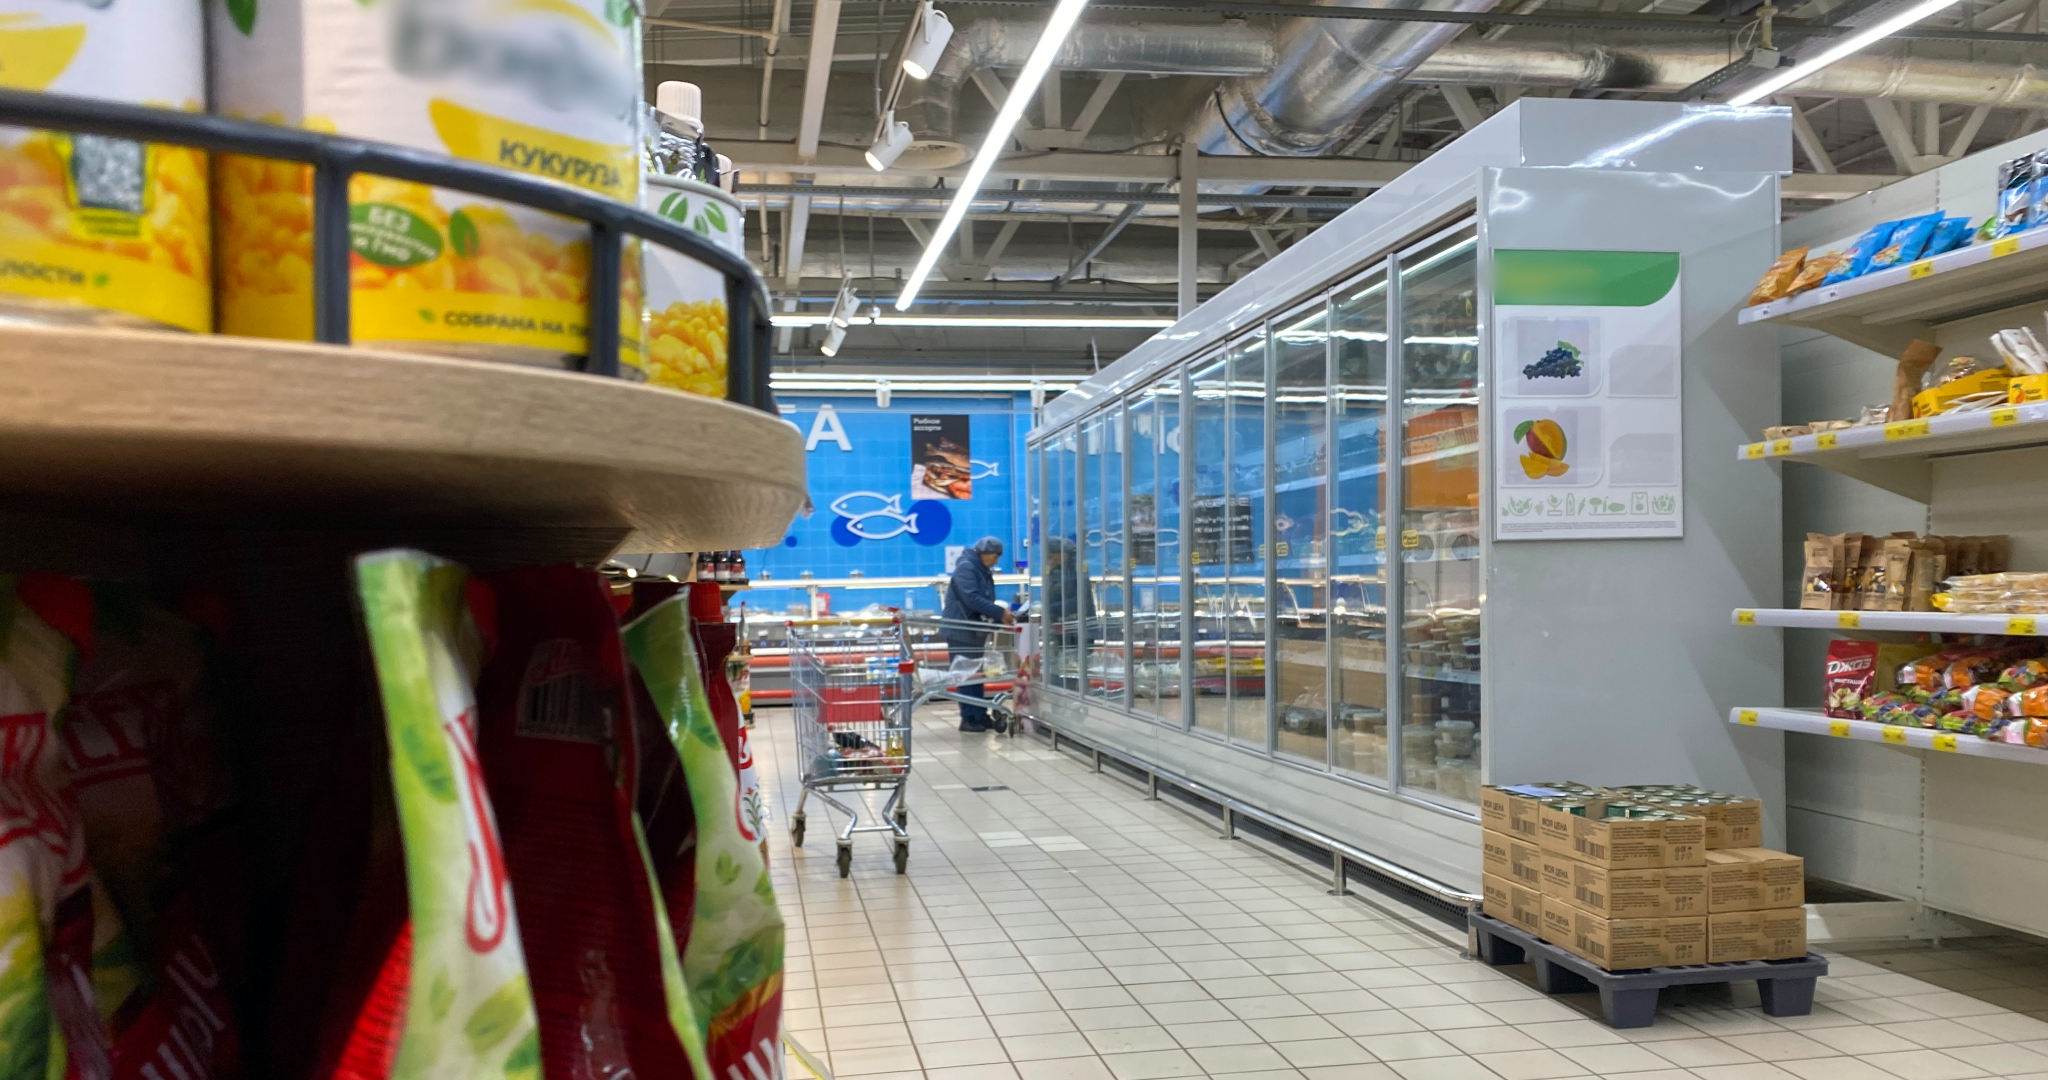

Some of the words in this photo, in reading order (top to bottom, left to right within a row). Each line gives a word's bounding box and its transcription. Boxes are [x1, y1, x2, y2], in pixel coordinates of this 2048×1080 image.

[500, 140, 622, 188] КУКУРУЗА
[367, 206, 411, 233] БЕЗ
[444, 310, 537, 331] СОБРАНА
[541, 320, 564, 334] НА
[1541, 817, 1554, 827] МОЯ
[1554, 820, 1568, 832] ЦЕНА
